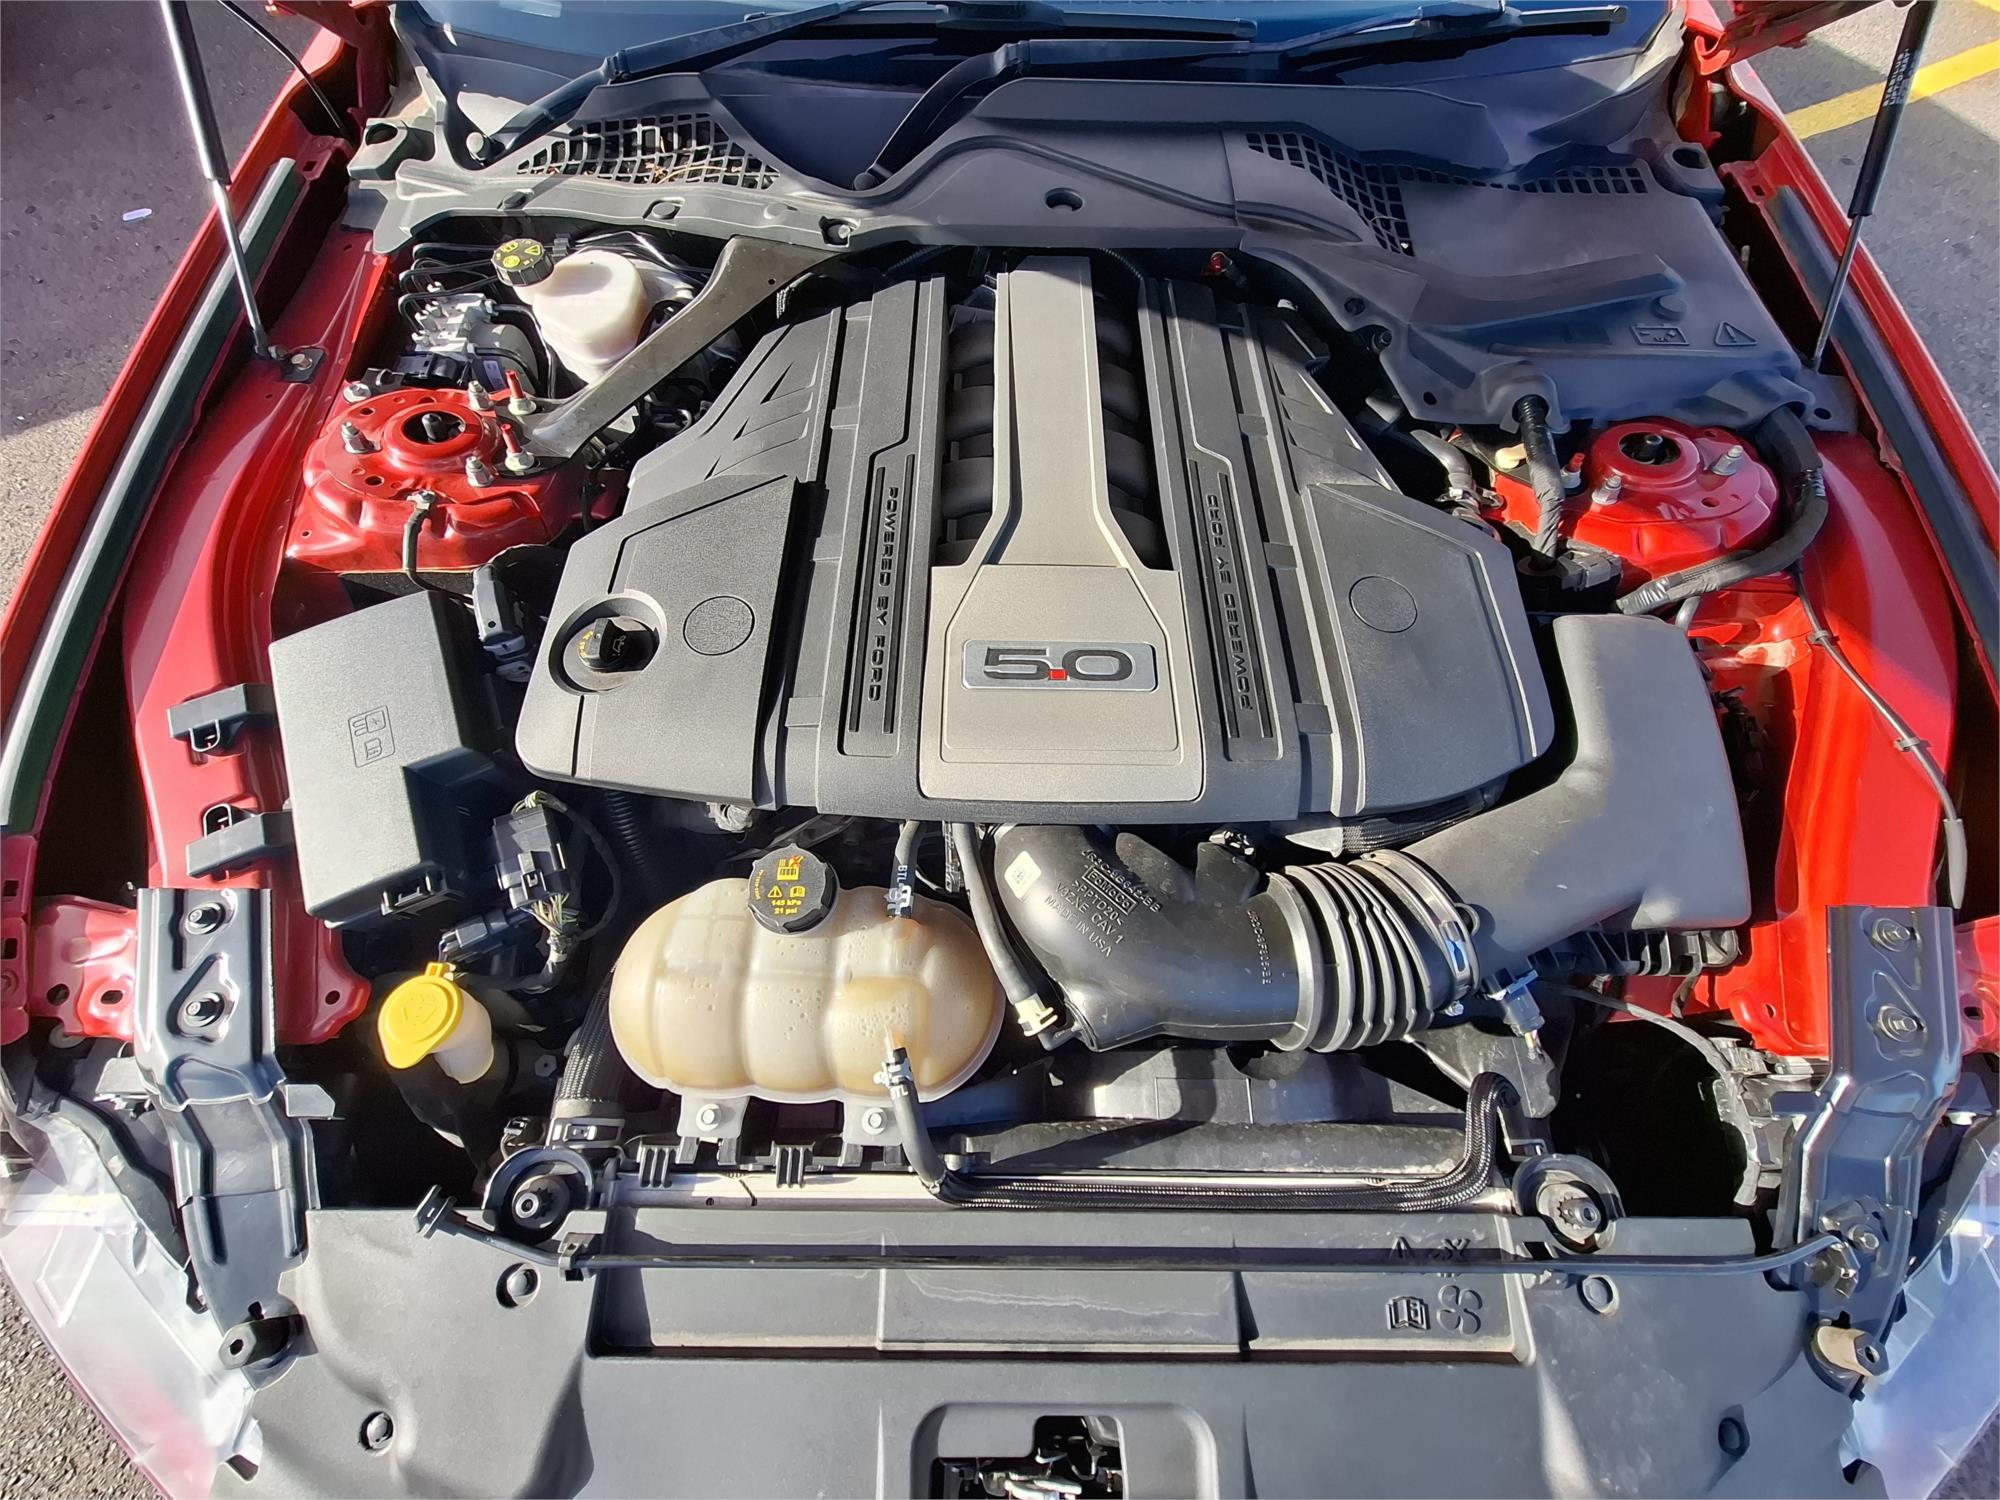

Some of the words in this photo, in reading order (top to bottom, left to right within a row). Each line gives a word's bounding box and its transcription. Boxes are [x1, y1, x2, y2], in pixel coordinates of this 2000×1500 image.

[879, 487, 899, 587] POWERED
[1207, 495, 1226, 548] FORD
[1216, 556, 1232, 585] BY
[876, 596, 890, 626] BY
[868, 635, 886, 701] FORD
[984, 647, 1134, 682] 5.0
[1224, 594, 1253, 710] POWERED
[1087, 870, 1130, 909] FoMoCo
[1044, 895, 1077, 921] MADE
[1076, 920, 1090, 935] IN
[1088, 932, 1112, 957] USA
[1091, 913, 1116, 935] CAV
[1115, 934, 1124, 944] 1
